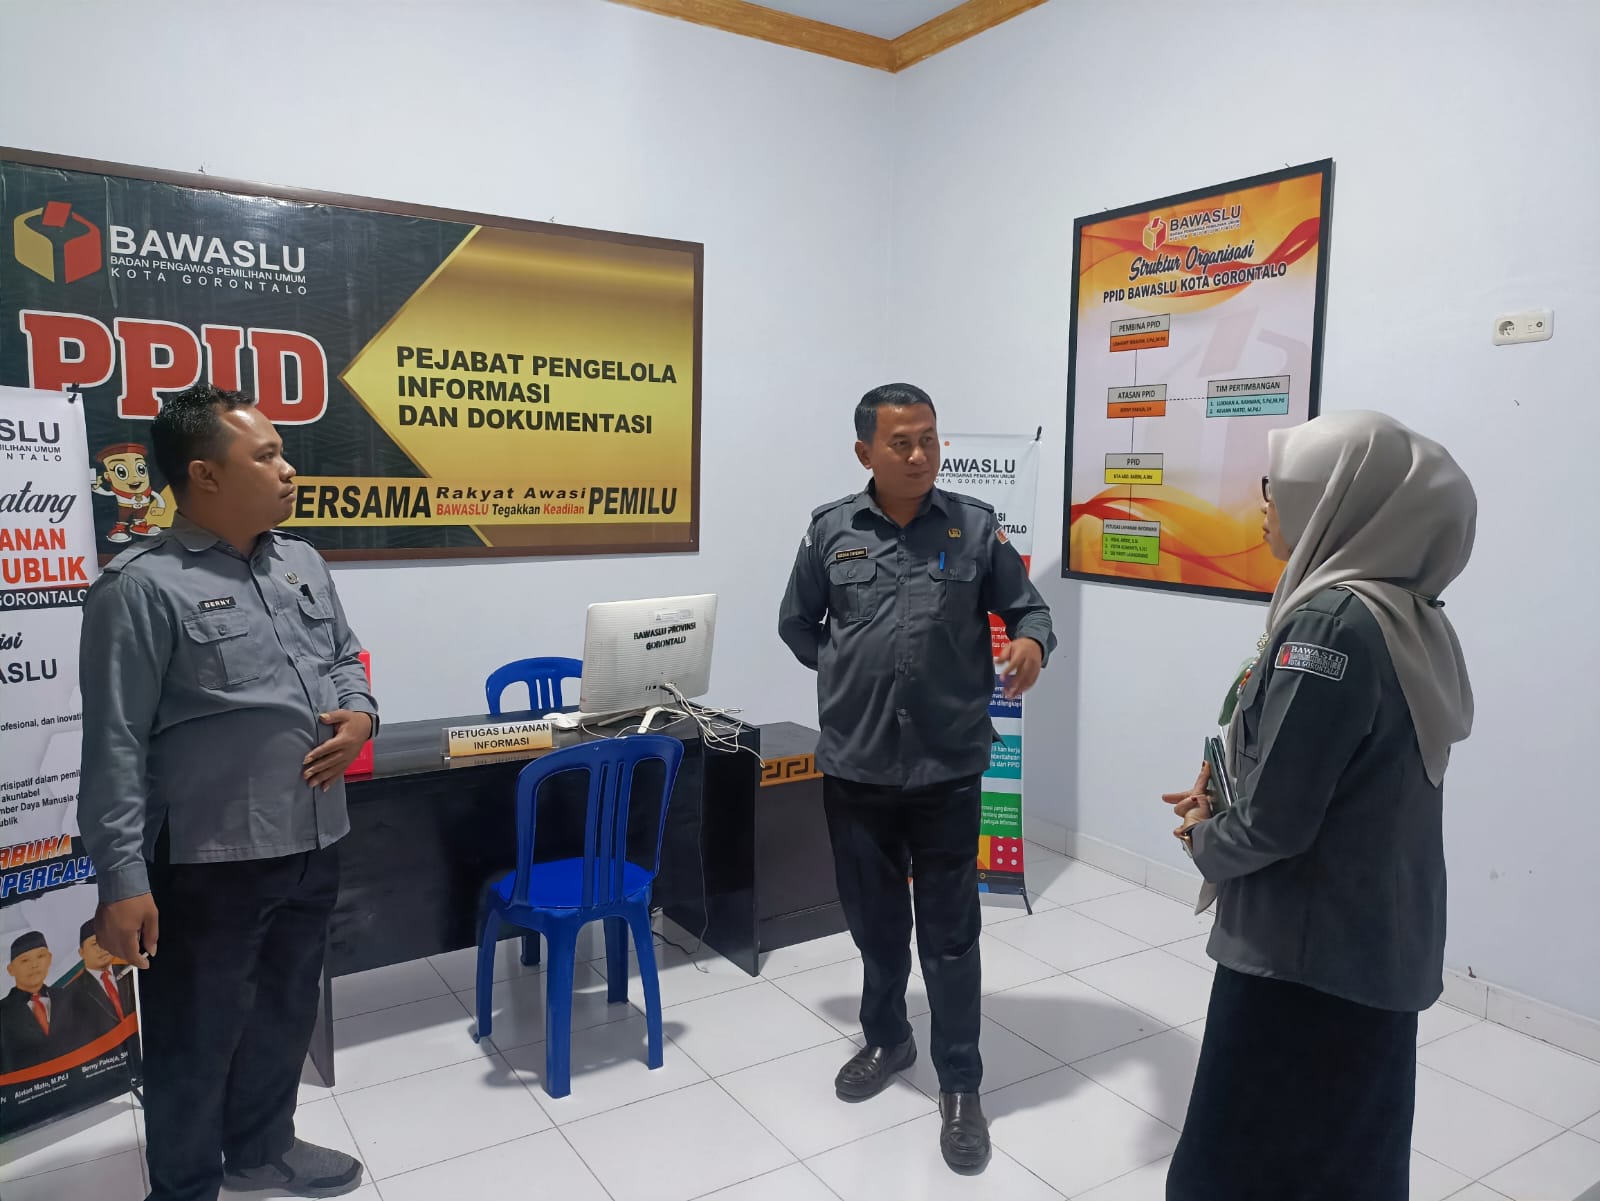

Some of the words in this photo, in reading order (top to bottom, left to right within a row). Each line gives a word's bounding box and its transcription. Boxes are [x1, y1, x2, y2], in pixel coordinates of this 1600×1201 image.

[1170, 205, 1241, 231] BAWASLU
[110, 225, 305, 272] BAWASLU
[111, 256, 149, 268] BADAN
[153, 260, 213, 275] PENGAWAS
[217, 267, 272, 280] PEMILIHAN
[275, 273, 306, 283] UMUM
[1128, 256, 1181, 282] Struktur
[1185, 239, 1256, 275] Organisasi
[111, 268, 166, 282] KOTA
[183, 274, 307, 295] GORONTALO
[1103, 289, 1125, 303] PPID
[1127, 280, 1177, 300] BAWASLU
[1180, 275, 1210, 291] KOTA
[1213, 262, 1287, 287] GORONTALO
[1118, 321, 1146, 332] PEMBINA
[1146, 320, 1161, 329] PPID
[19, 309, 329, 425] PPID
[396, 345, 525, 375] PEJABAT
[532, 355, 677, 384] PENGELOLA
[398, 375, 551, 404] INFORMASI
[1117, 391, 1140, 400] ATASAN
[1142, 390, 1156, 399] PPID
[1216, 385, 1228, 393] TIM
[1228, 381, 1281, 393] PERTIMBANGAN
[399, 404, 458, 428] DAN
[467, 407, 653, 434] DOKUMENTASI
[0, 418, 60, 444] SLU
[0, 444, 32, 452] ILIHAN
[34, 446, 61, 454] UMUM
[6, 452, 62, 462] NTALO
[940, 458, 1016, 474] AWASLU
[1126, 458, 1141, 466] PPID
[0, 481, 77, 524] atang
[295, 485, 432, 519] ERSAMA
[436, 486, 515, 502] Rakyat
[523, 486, 587, 499] Awasi
[588, 487, 677, 515] PEMILU
[436, 503, 489, 516] BAWASLU
[492, 503, 541, 518] Tegakkan
[543, 502, 585, 515] Keadilan
[0, 528, 66, 551] ANAN
[2, 556, 88, 584] UBLIK
[0, 632, 23, 650] isi
[1291, 645, 1344, 663] BAWASLU
[0, 719, 39, 731] ofesional,
[41, 717, 55, 726] dan
[57, 712, 83, 723] inovati
[450, 727, 500, 740] PETUGAS
[502, 723, 549, 735] LAYANAN
[473, 737, 530, 750] INFORMASI
[0, 778, 33, 792] rtisipatif
[35, 775, 59, 785] dalam
[60, 769, 80, 782] pemil
[0, 805, 19, 815] mber
[20, 801, 40, 812] Daya
[42, 795, 74, 806] Manusia
[2, 788, 40, 803] akuntabel
[0, 817, 19, 828] ublik
